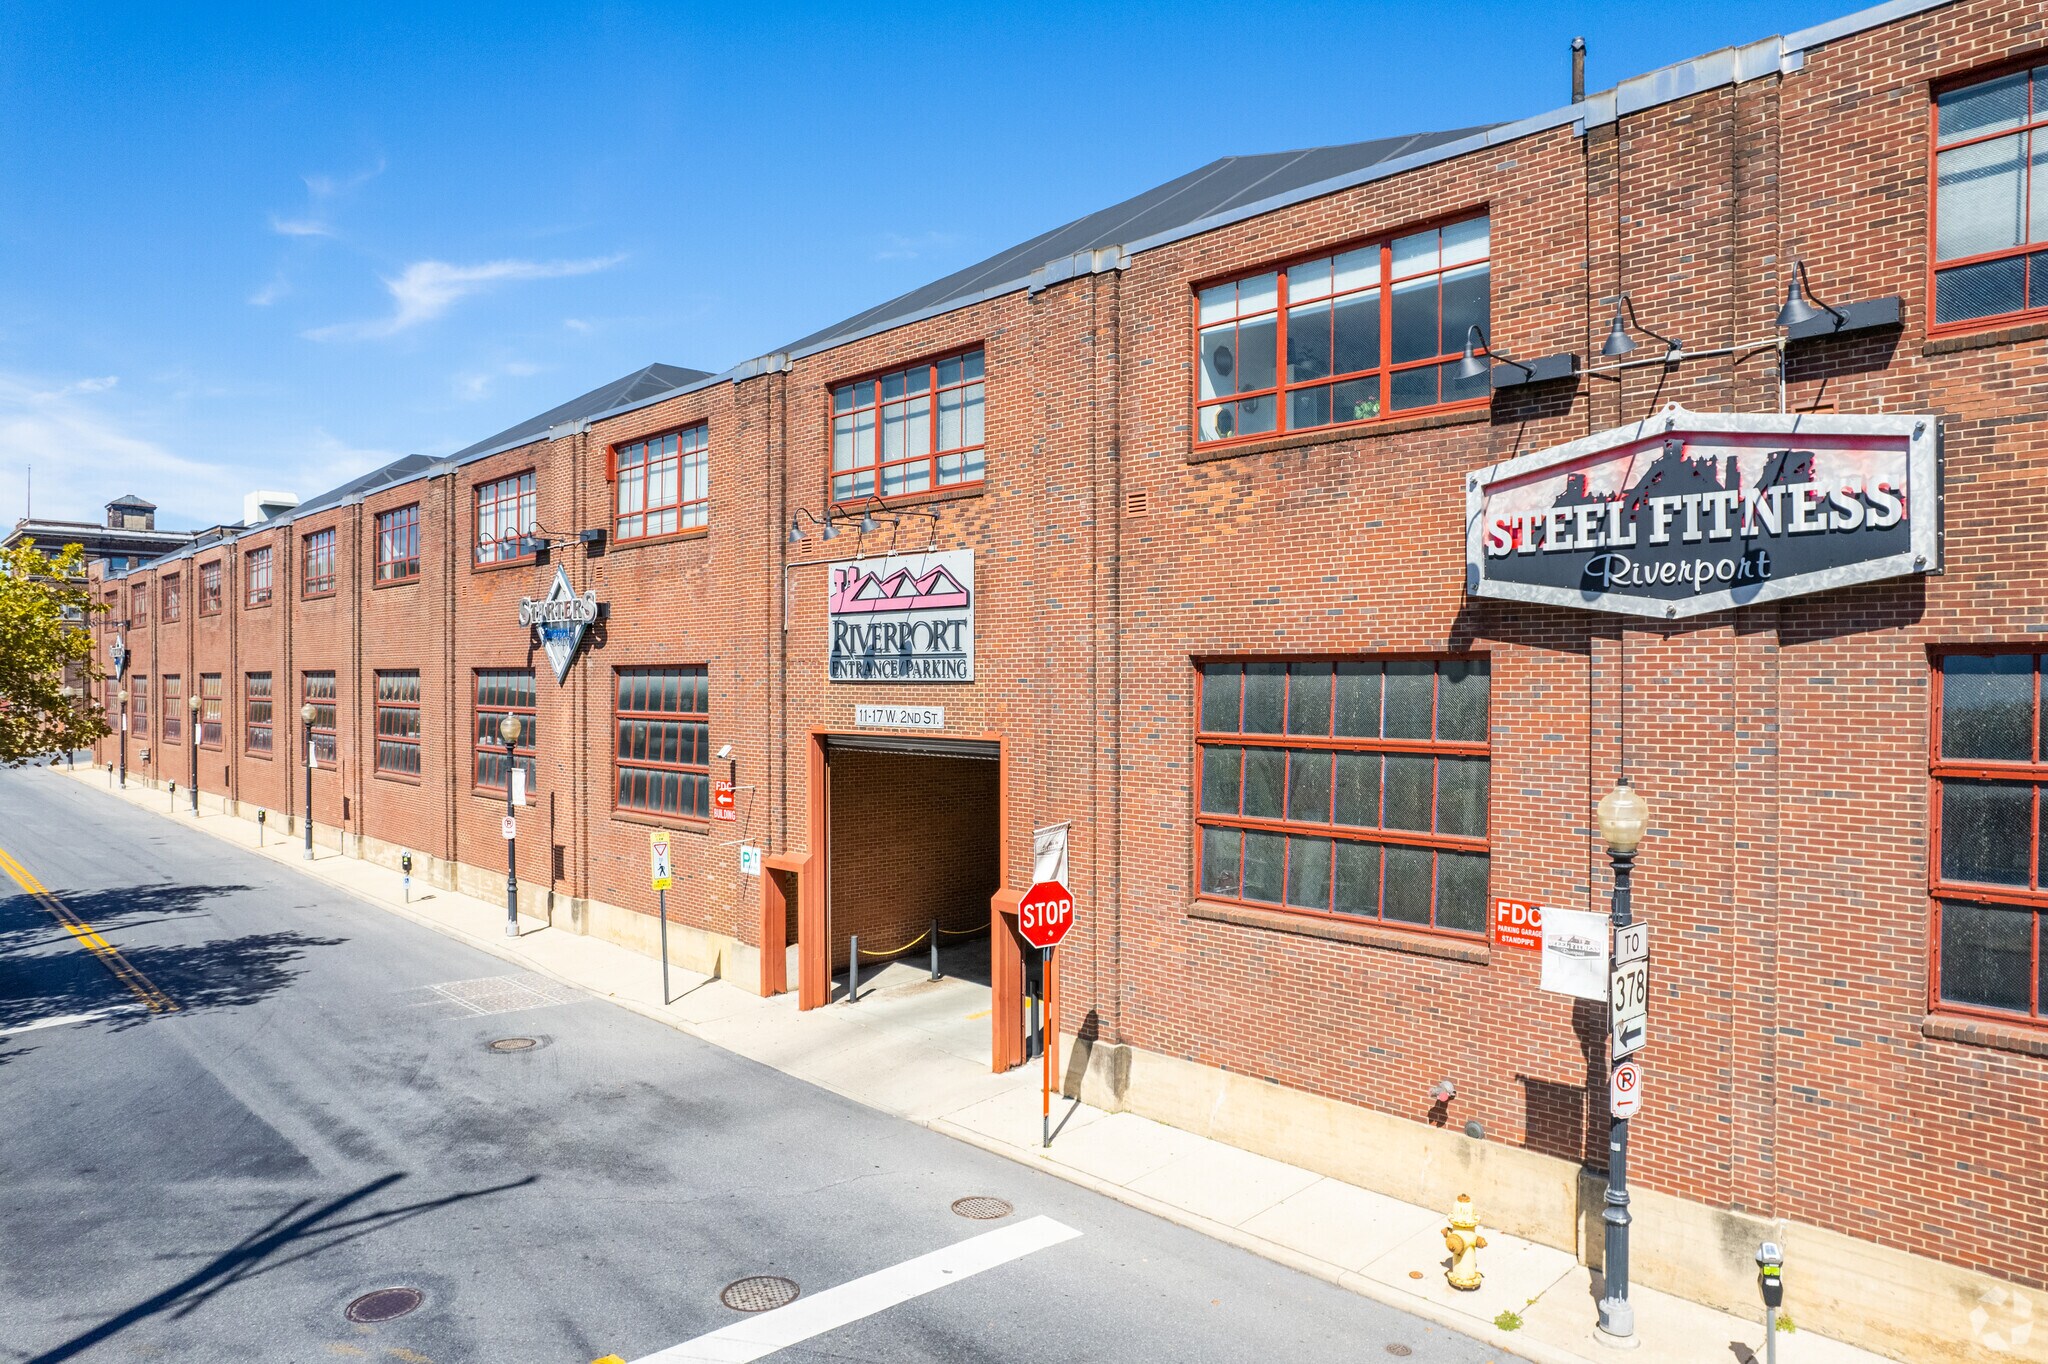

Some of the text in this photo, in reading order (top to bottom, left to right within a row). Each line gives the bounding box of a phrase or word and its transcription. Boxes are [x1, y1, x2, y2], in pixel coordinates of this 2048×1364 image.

[1487, 474, 1905, 557] STEEL FITNESS
[1584, 548, 1773, 592] Riverport
[518, 590, 598, 628] STARTERS
[831, 617, 968, 658] RIVERPORT
[859, 709, 940, 725] 11-17 W. 2ND ST.
[1022, 898, 1072, 928] STOP
[1498, 901, 1542, 928] FDC
[1497, 925, 1543, 938] PARKING GARAGE
[1501, 935, 1535, 947] STANDPIPE
[1624, 934, 1639, 955] TO
[1615, 969, 1645, 1012] 378
